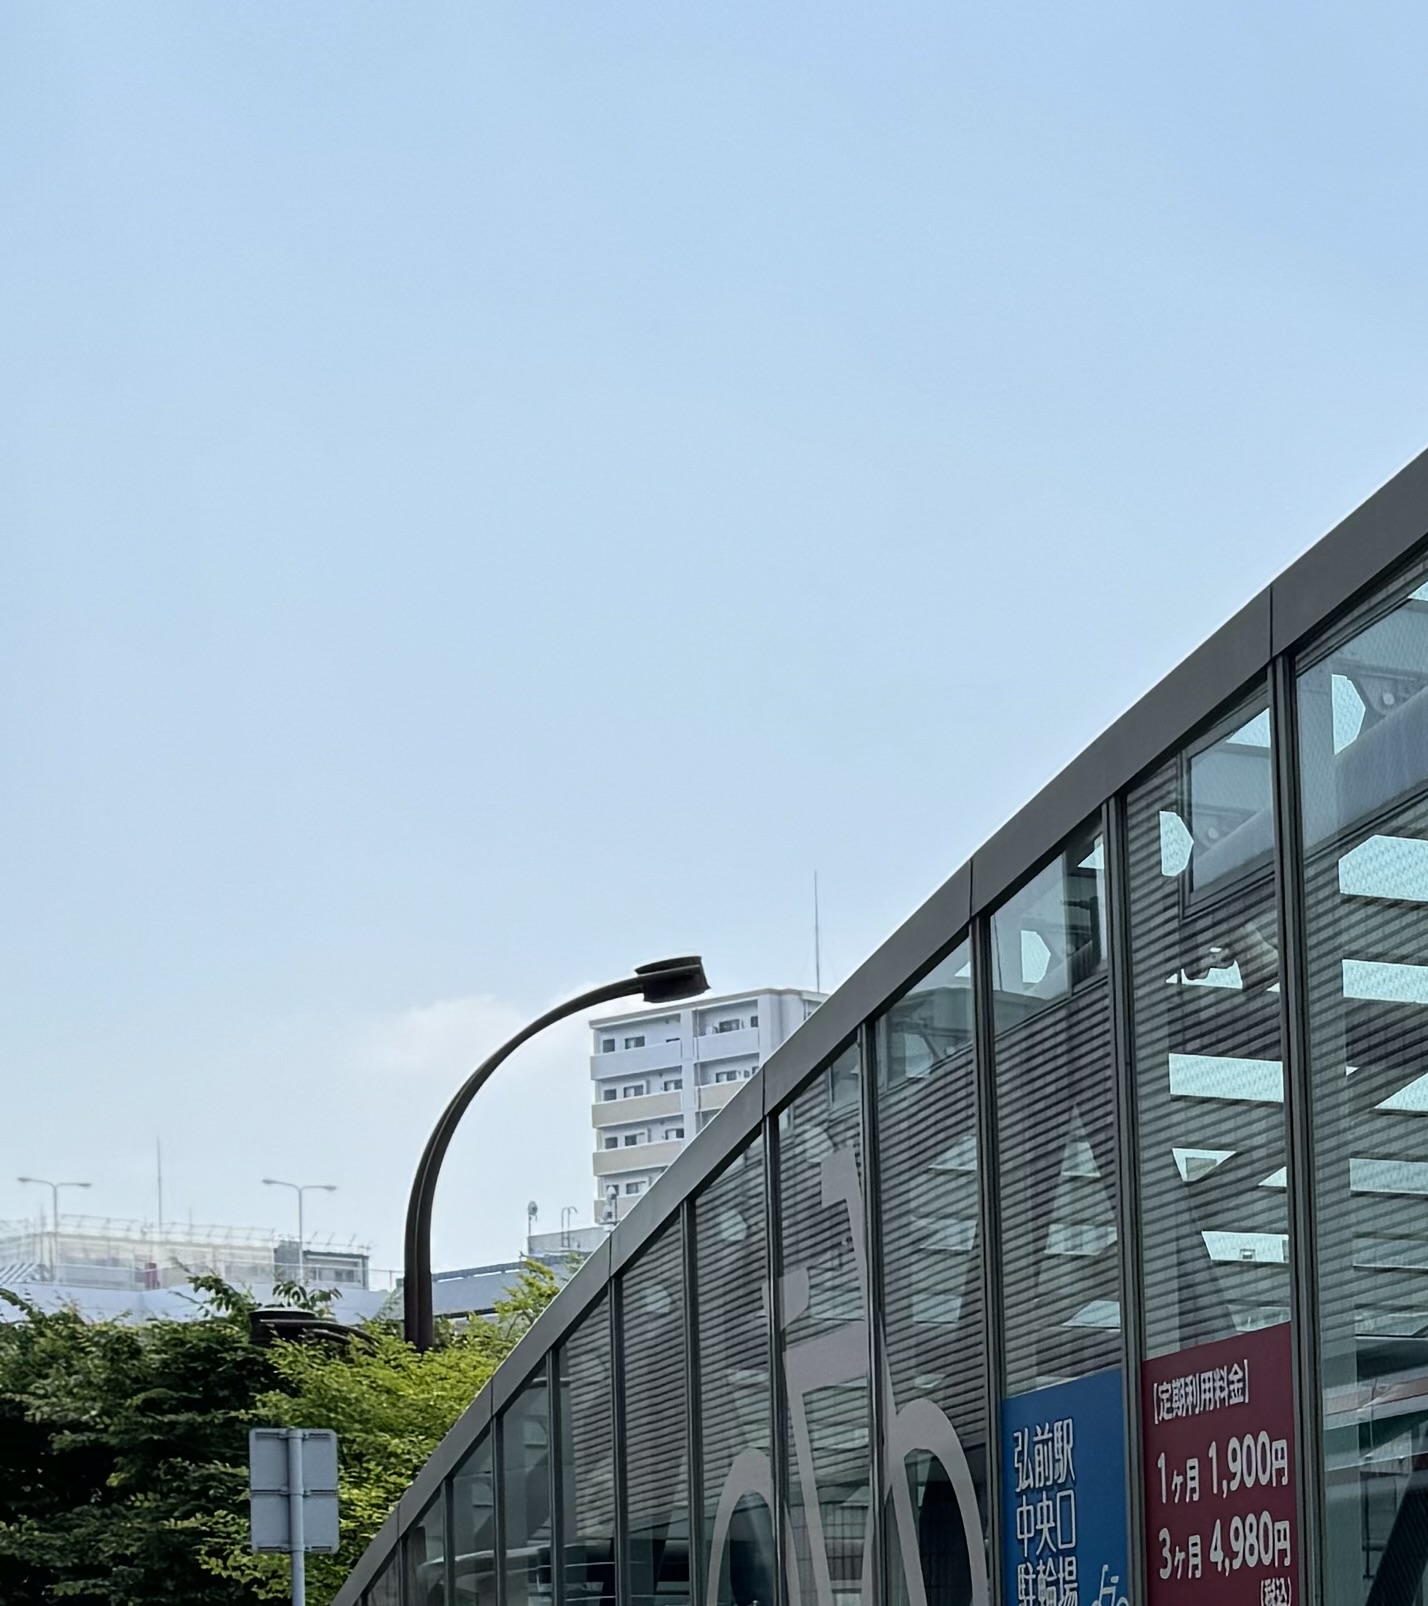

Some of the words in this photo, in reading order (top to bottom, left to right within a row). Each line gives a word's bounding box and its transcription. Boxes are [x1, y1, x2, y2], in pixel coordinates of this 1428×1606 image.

[1013, 1417, 1075, 1494] 弘前駅
[1208, 1429, 1289, 1499] 1,900円
[1015, 1488, 1076, 1559] 中央口
[1209, 1510, 1291, 1577] 4,980円
